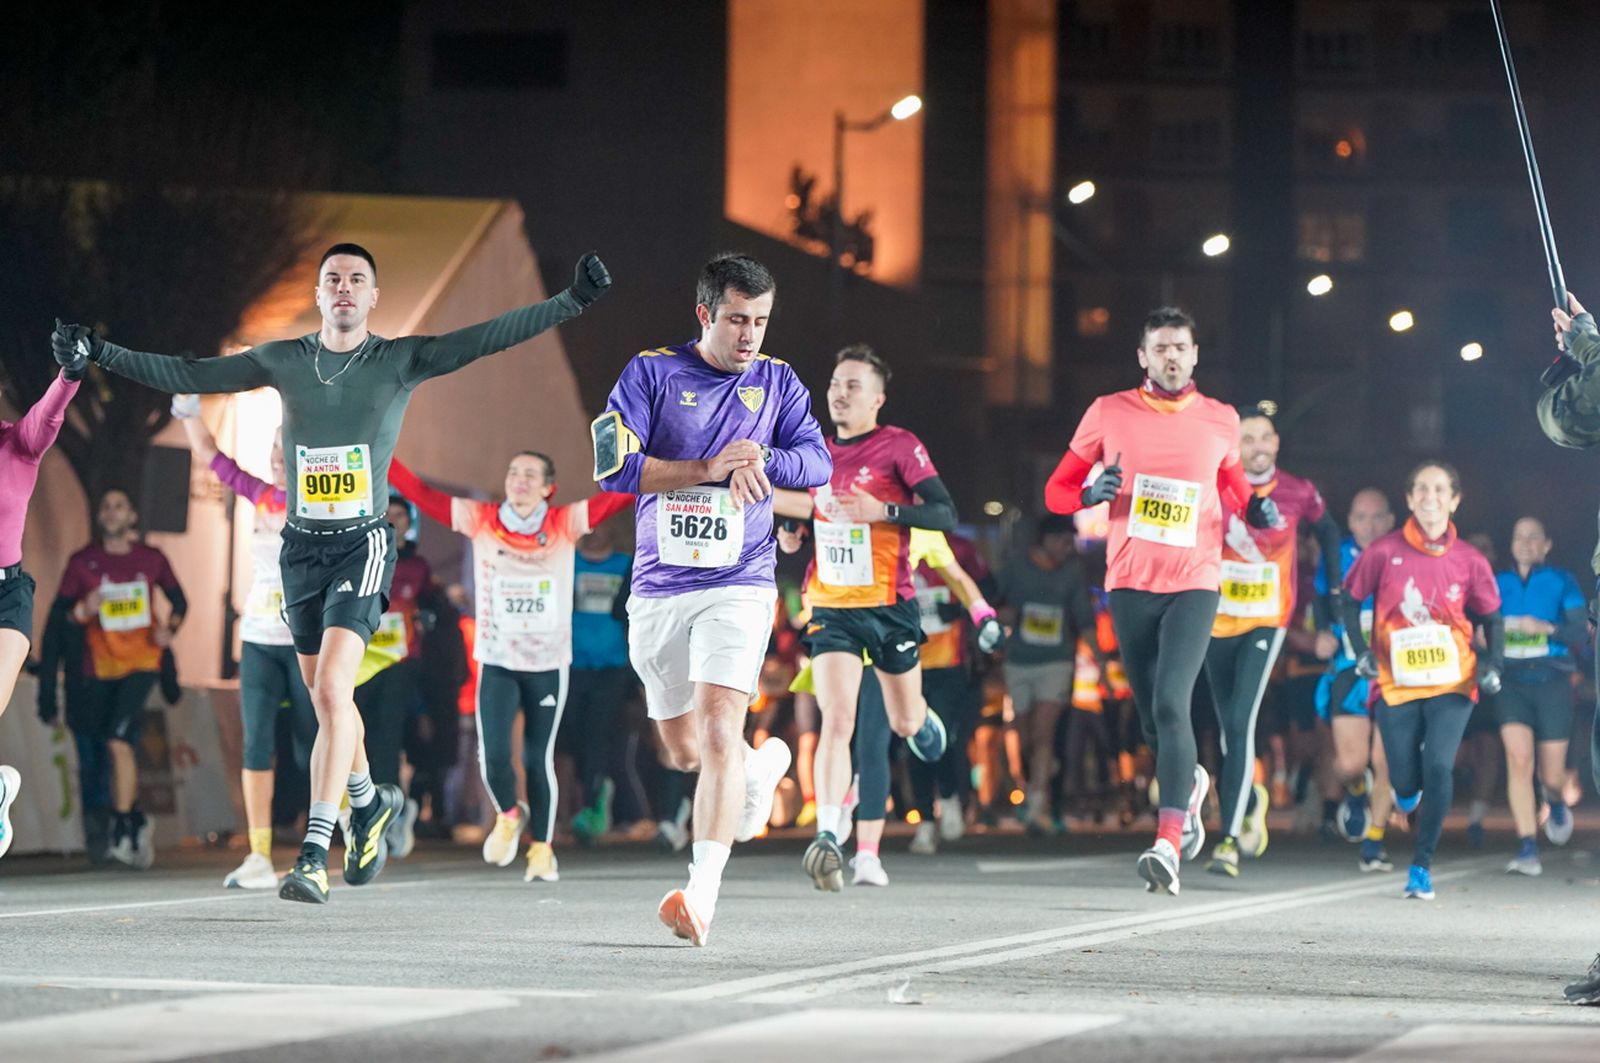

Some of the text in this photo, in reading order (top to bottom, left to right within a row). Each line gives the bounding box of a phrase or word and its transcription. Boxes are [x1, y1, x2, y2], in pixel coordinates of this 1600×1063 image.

[306, 472, 355, 495] 9079
[665, 503, 681, 512] SAN
[675, 494, 712, 504] NOCHE DE
[1142, 498, 1190, 524] 13937
[670, 514, 728, 541] 5628
[1230, 582, 1268, 597] 8920
[505, 597, 545, 613] 3226
[1407, 647, 1446, 666] 8919
